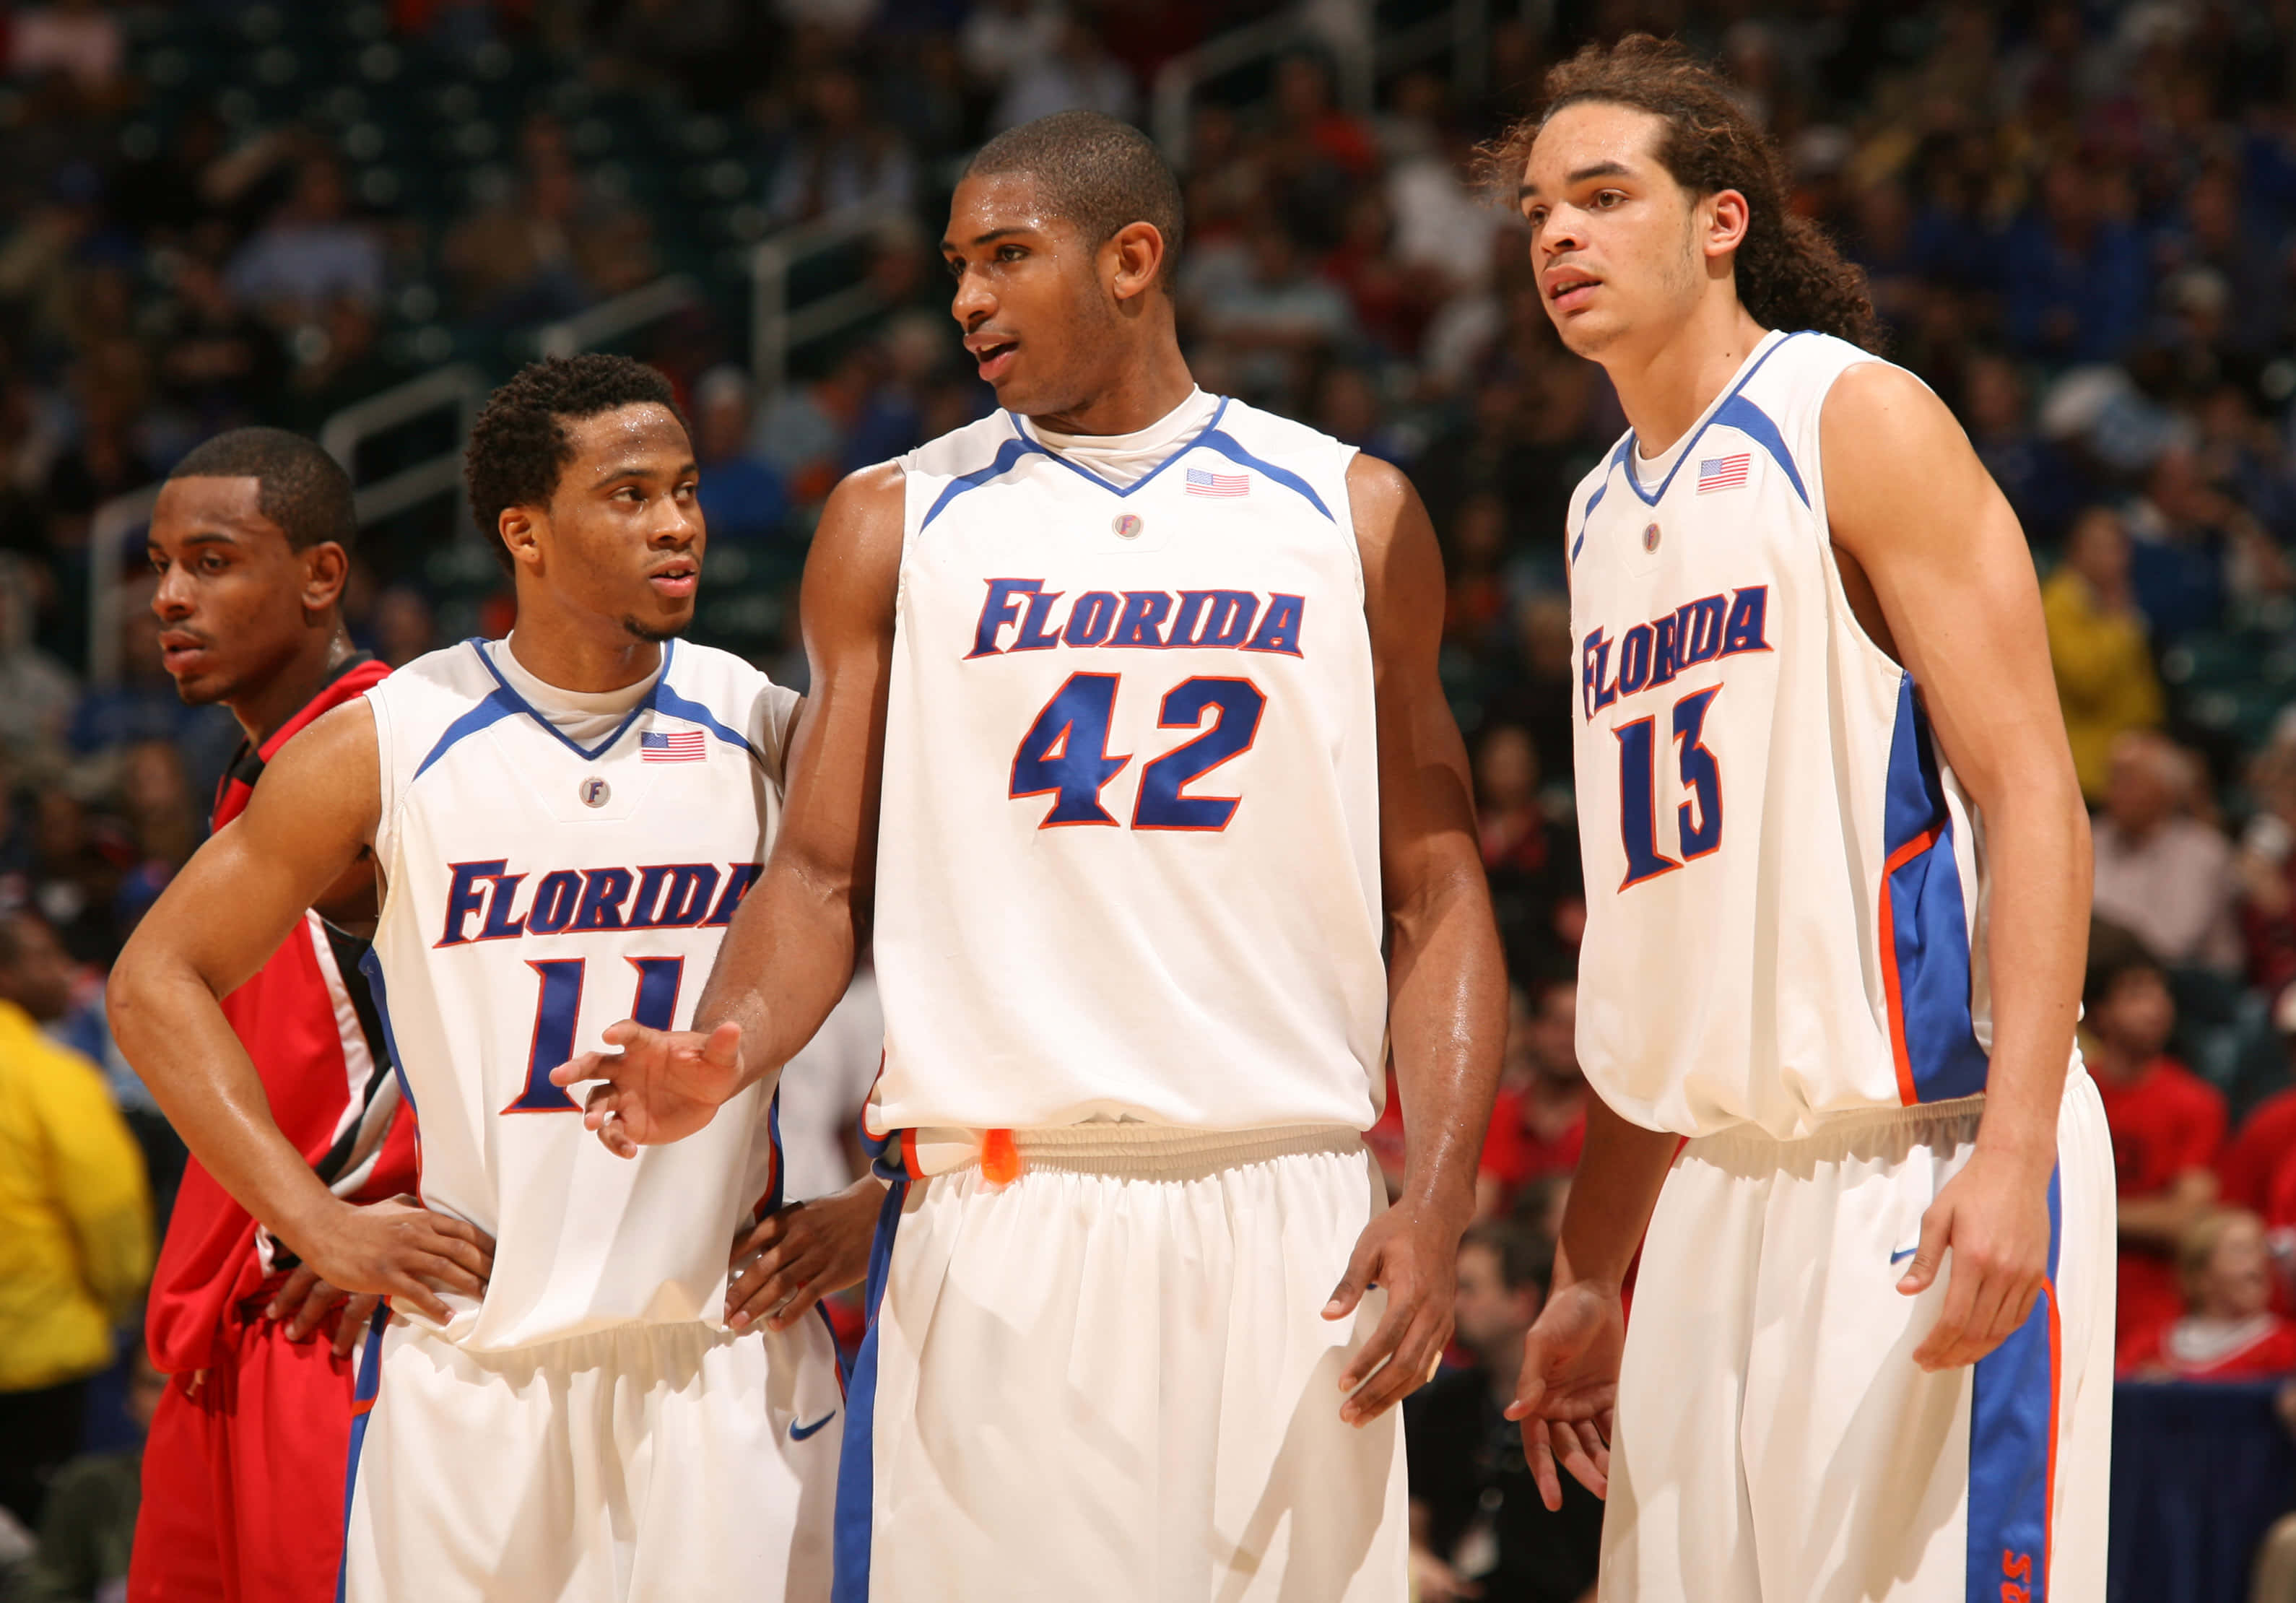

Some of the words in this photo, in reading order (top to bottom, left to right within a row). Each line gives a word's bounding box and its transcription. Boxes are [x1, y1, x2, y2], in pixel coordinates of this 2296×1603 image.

[962, 578, 1305, 660] FLORIDA
[1583, 585, 1775, 726] FLORIDA
[586, 781, 604, 804] F
[1009, 671, 1267, 832] 42
[1612, 682, 1724, 895] 13
